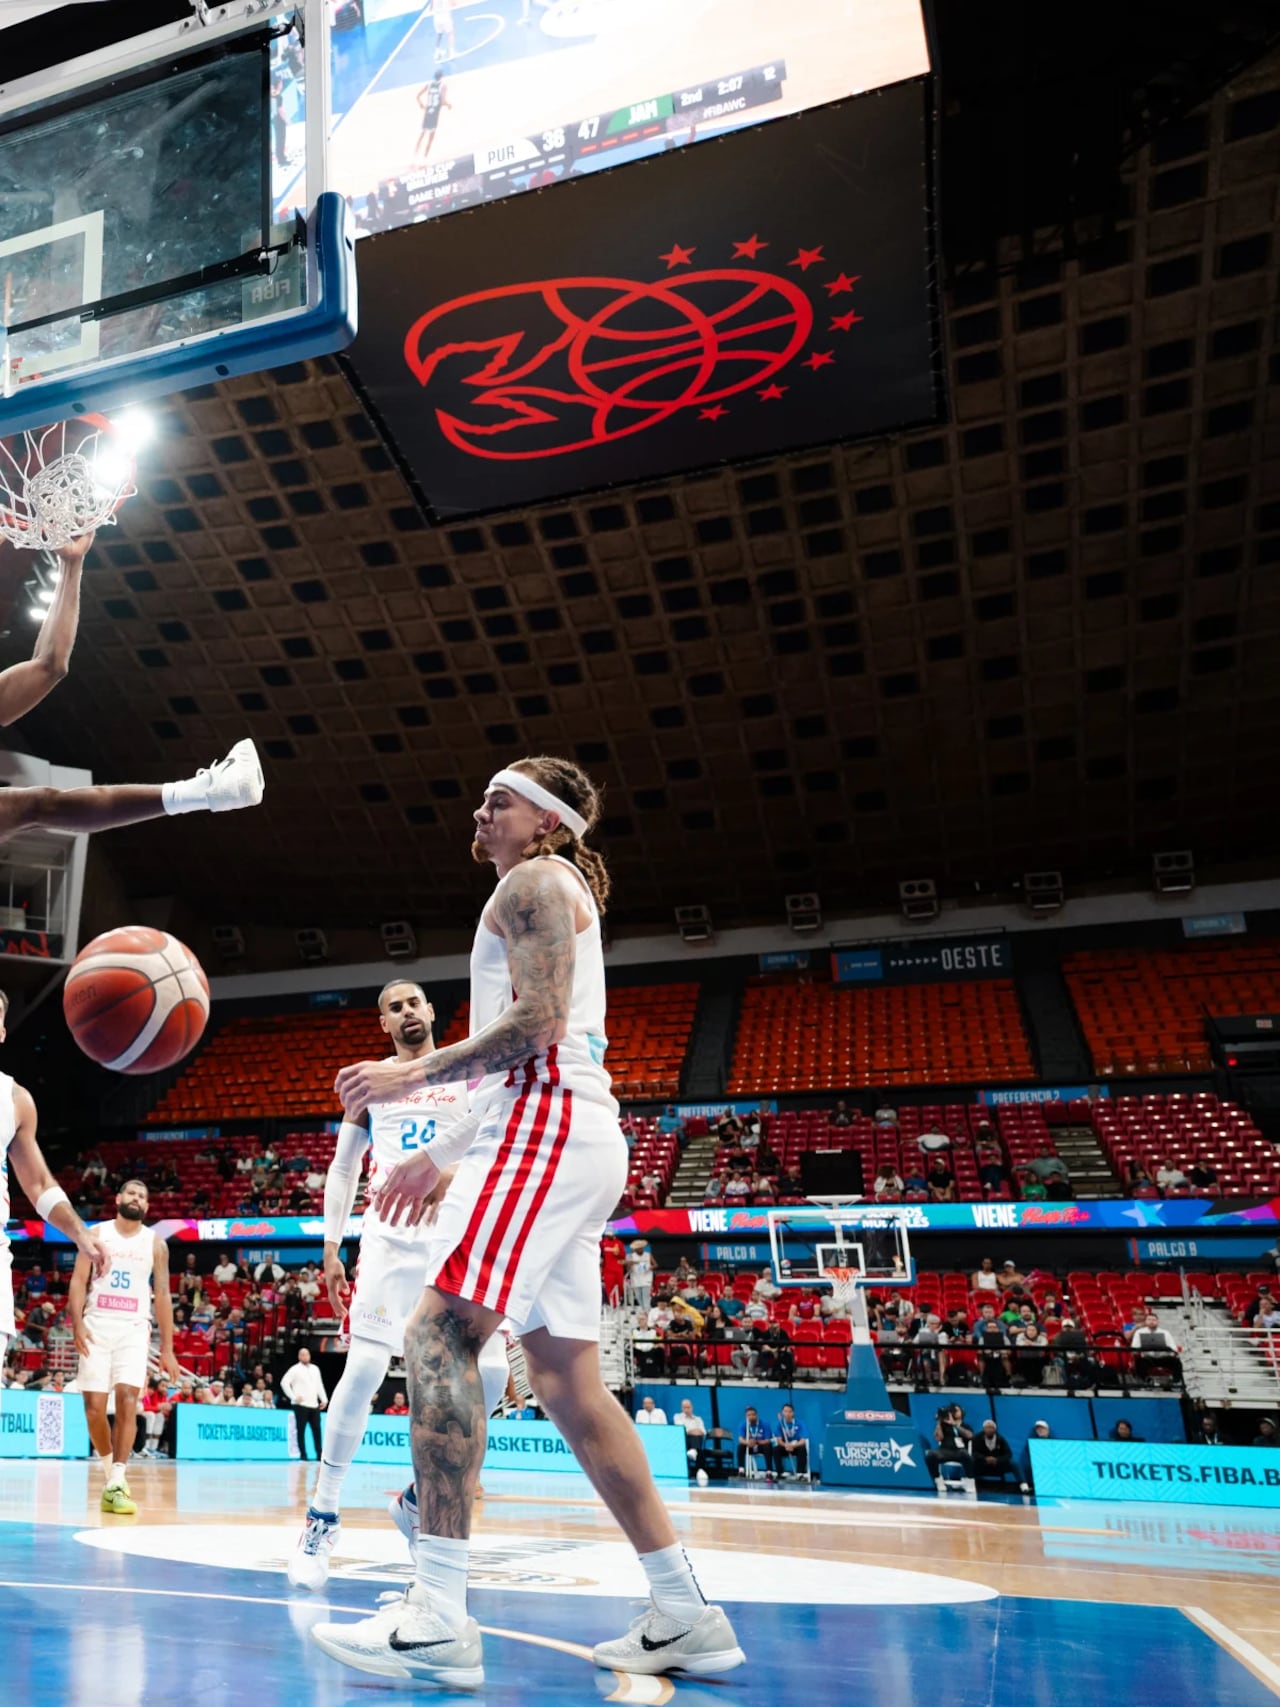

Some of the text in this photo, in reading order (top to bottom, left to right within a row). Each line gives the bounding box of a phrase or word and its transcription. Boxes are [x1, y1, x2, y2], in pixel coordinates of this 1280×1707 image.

[487, 145, 516, 165] PUR
[577, 117, 600, 141] 47
[627, 100, 659, 126] JAM
[941, 944, 1003, 970] OESTE
[425, 1087, 457, 1107] Rico
[400, 1119, 436, 1151] 24
[687, 1210, 728, 1233] VIENE
[972, 1204, 1019, 1228] VIENE
[716, 1245, 748, 1261] PALCO
[1148, 1241, 1186, 1257] PALCO
[110, 1269, 131, 1289] 35
[197, 1423, 288, 1441] TICKETS.FIBA.BASKETBALL
[833, 1447, 892, 1460] TURISMO
[840, 1459, 893, 1467] PUERTO RICO
